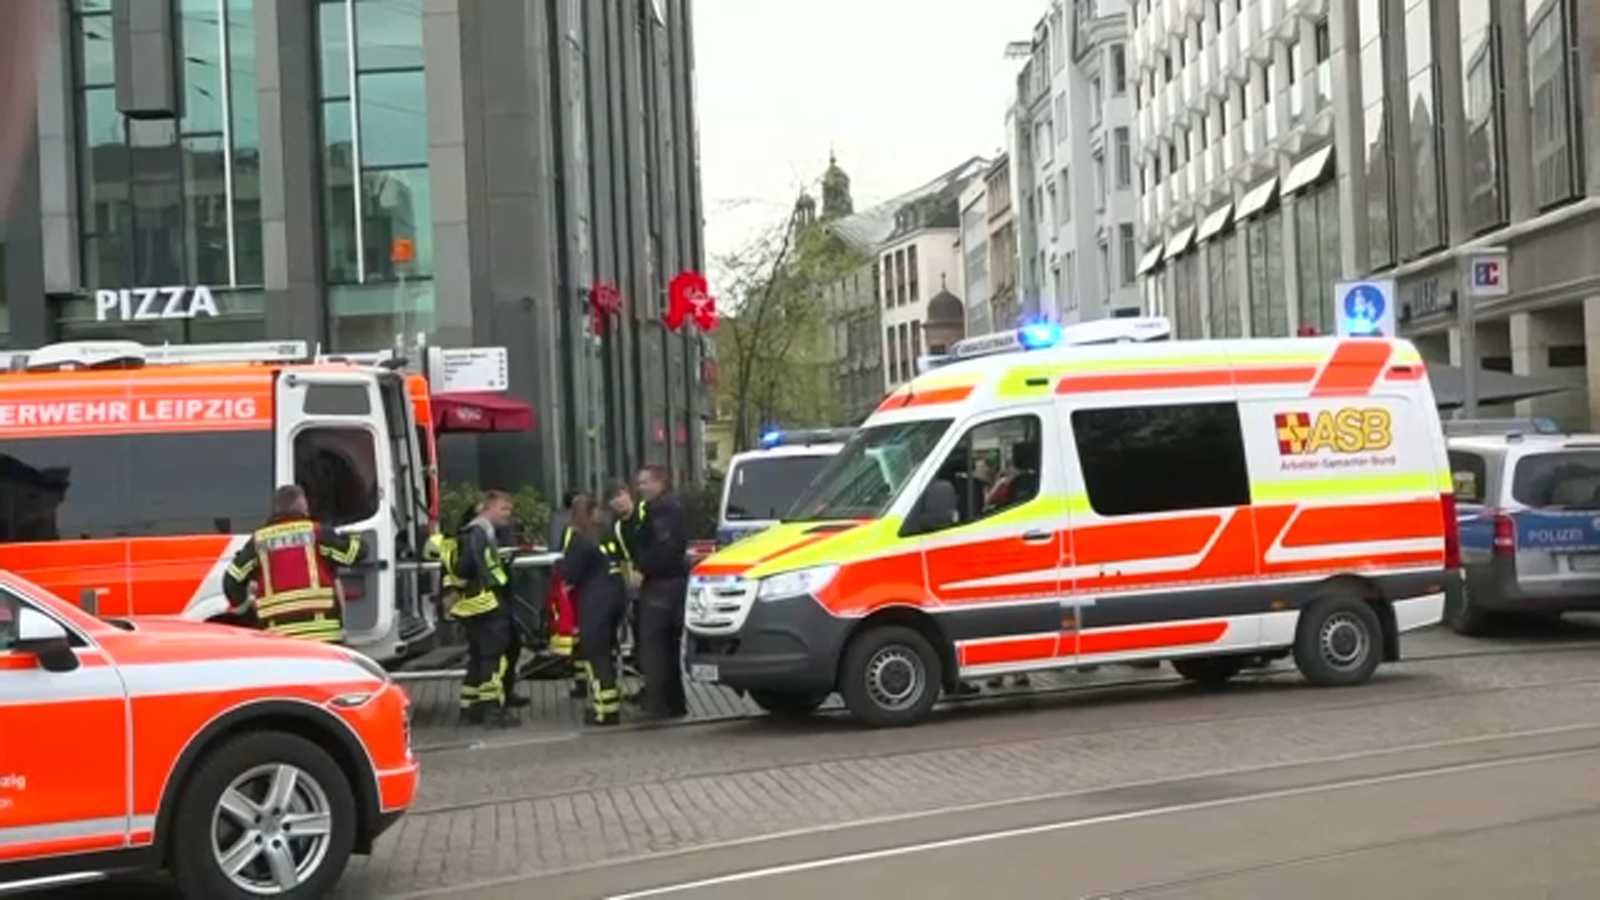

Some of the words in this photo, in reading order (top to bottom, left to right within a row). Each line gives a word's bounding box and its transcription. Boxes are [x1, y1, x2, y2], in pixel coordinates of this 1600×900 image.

[95, 285, 220, 321] PIZZA
[139, 398, 255, 421] LEIPZIG
[1311, 408, 1392, 453] ASB
[1527, 529, 1583, 542] POLIZEI
